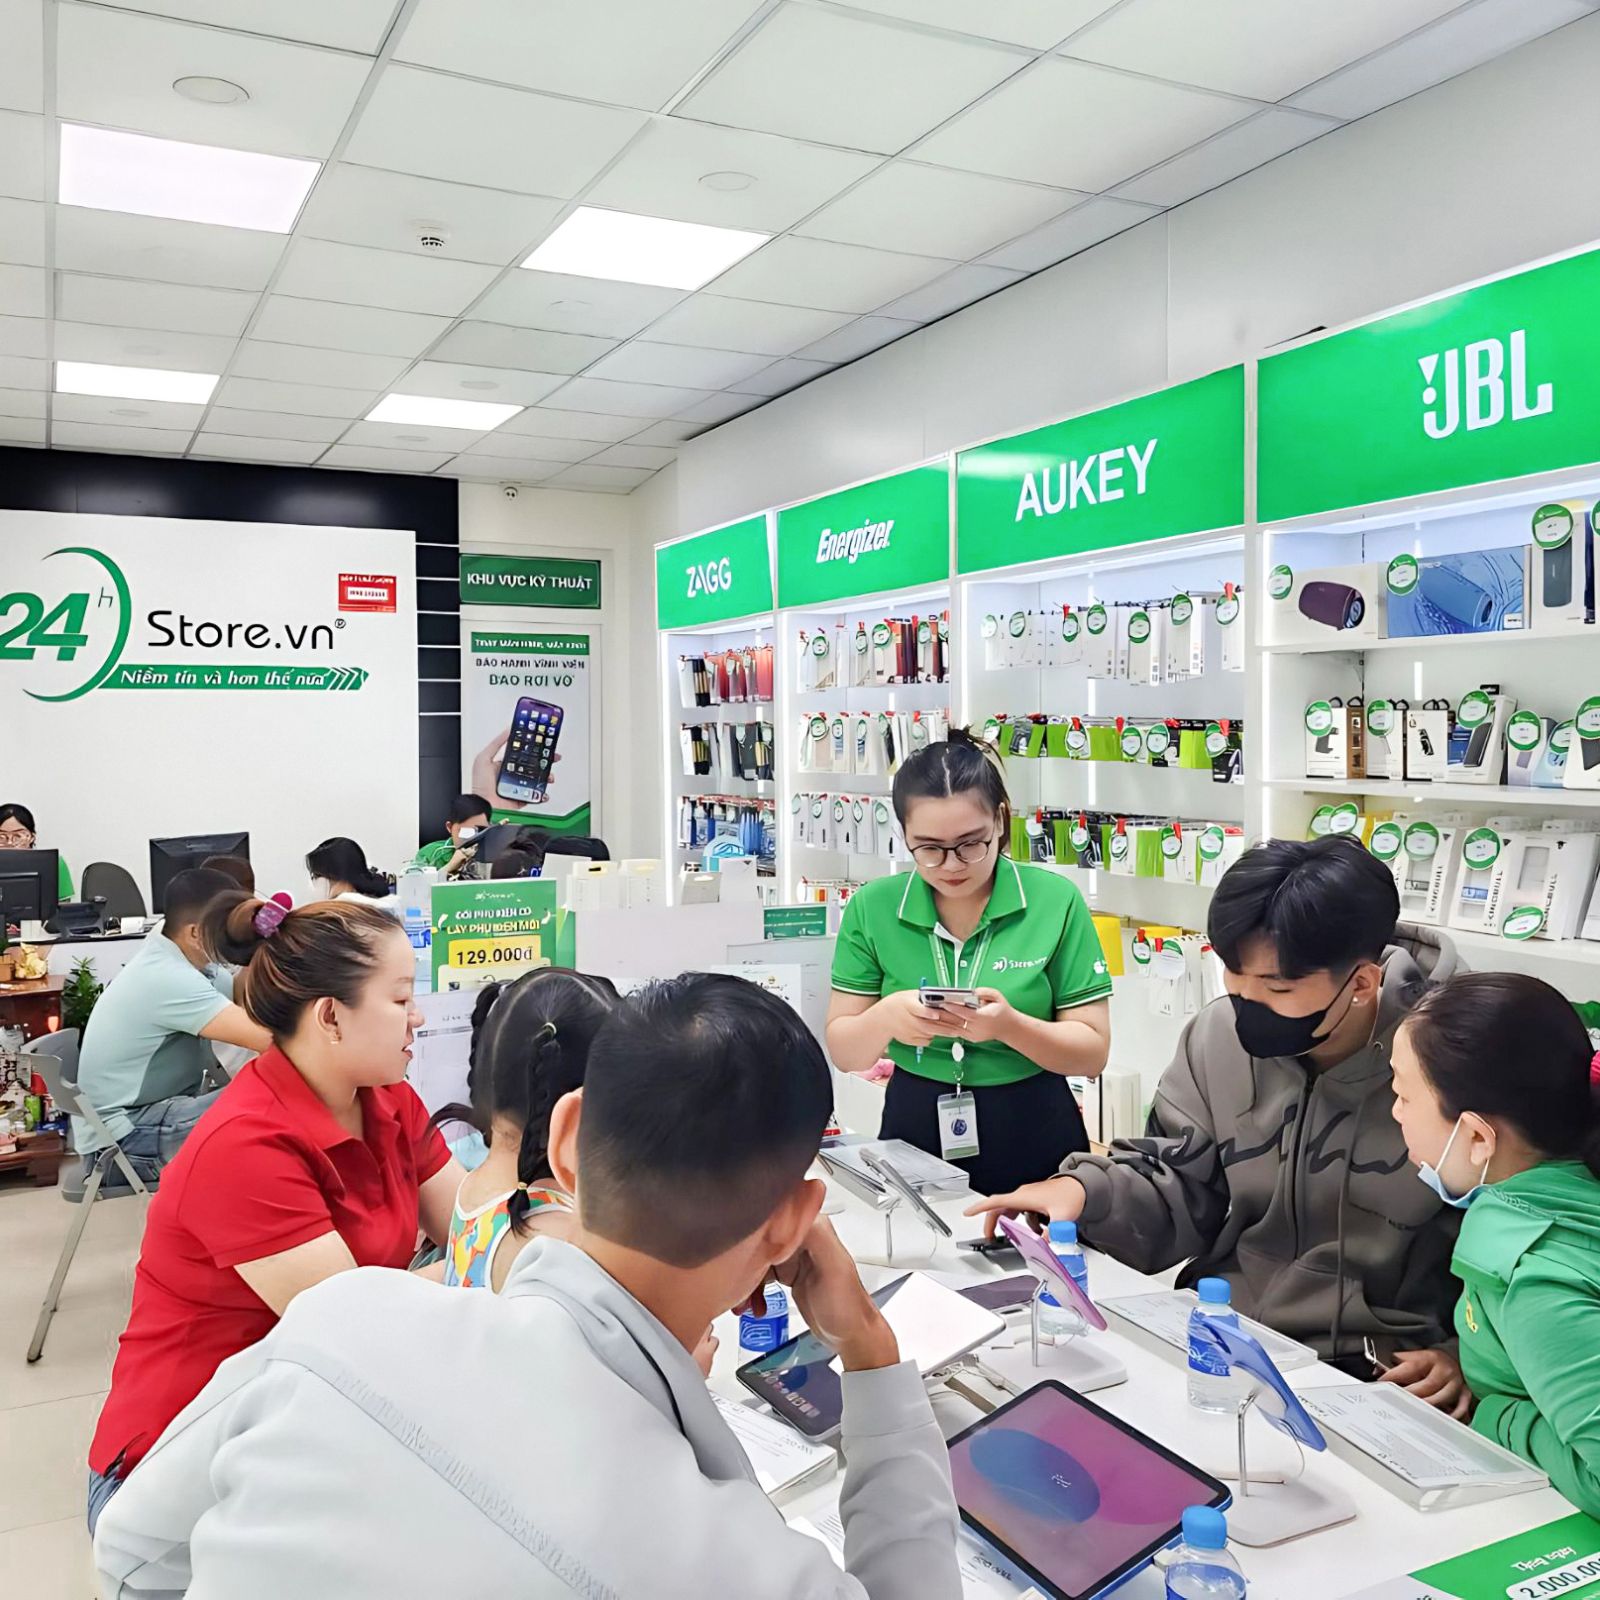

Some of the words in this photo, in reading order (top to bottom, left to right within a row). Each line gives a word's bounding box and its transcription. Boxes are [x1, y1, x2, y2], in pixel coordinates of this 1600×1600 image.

[1419, 329, 1554, 439] JBL
[1015, 438, 1159, 522] AUKEY
[815, 519, 894, 564] Energizer
[467, 573, 495, 585] KHU
[549, 575, 592, 591] THUẬT
[686, 557, 732, 598] ZAGG
[147, 610, 333, 650] Store.vn
[120, 666, 168, 684] Niềm
[204, 670, 222, 685] và
[227, 670, 258, 685] hơn
[1520, 1557, 1600, 1599] 2.000.00
